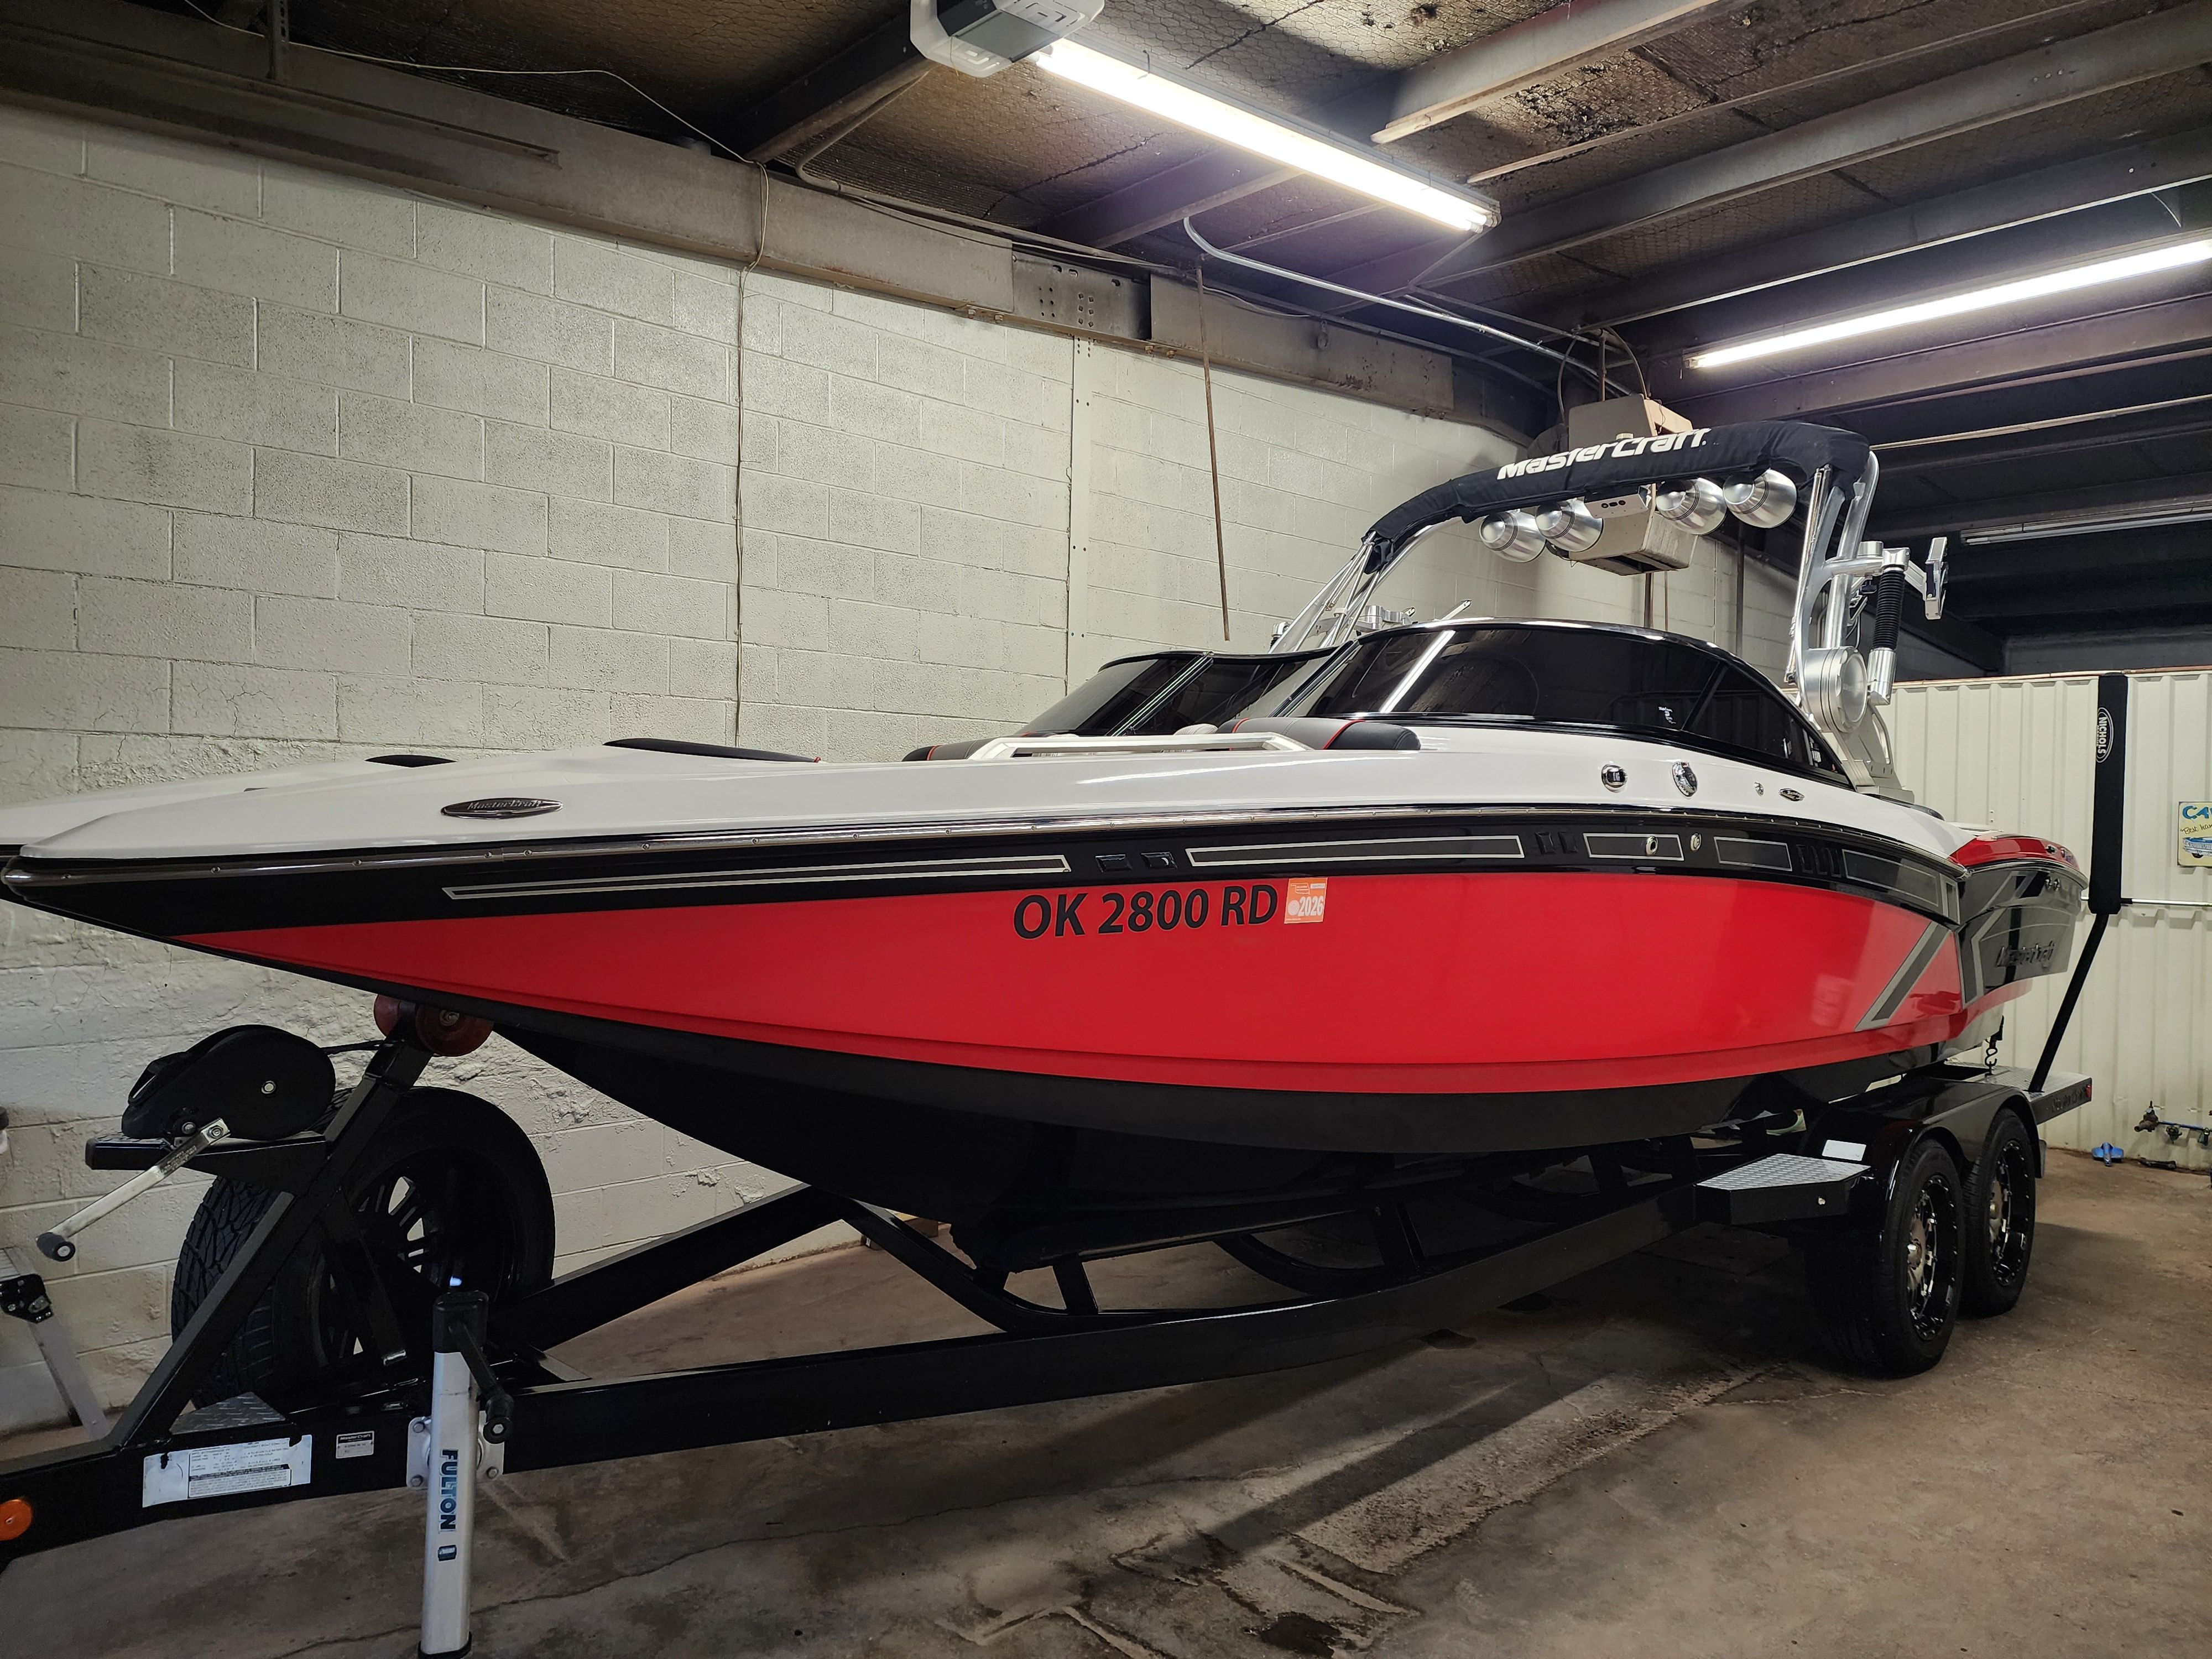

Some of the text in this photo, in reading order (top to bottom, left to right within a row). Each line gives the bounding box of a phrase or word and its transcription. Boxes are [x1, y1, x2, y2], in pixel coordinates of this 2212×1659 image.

[2098, 717, 2107, 754] NICHOLS
[2182, 805, 2212, 820] CA
[1014, 884, 1278, 940] OK 2800 RD
[1298, 896, 1324, 916] 2026
[440, 1449, 458, 1530] FULTON
